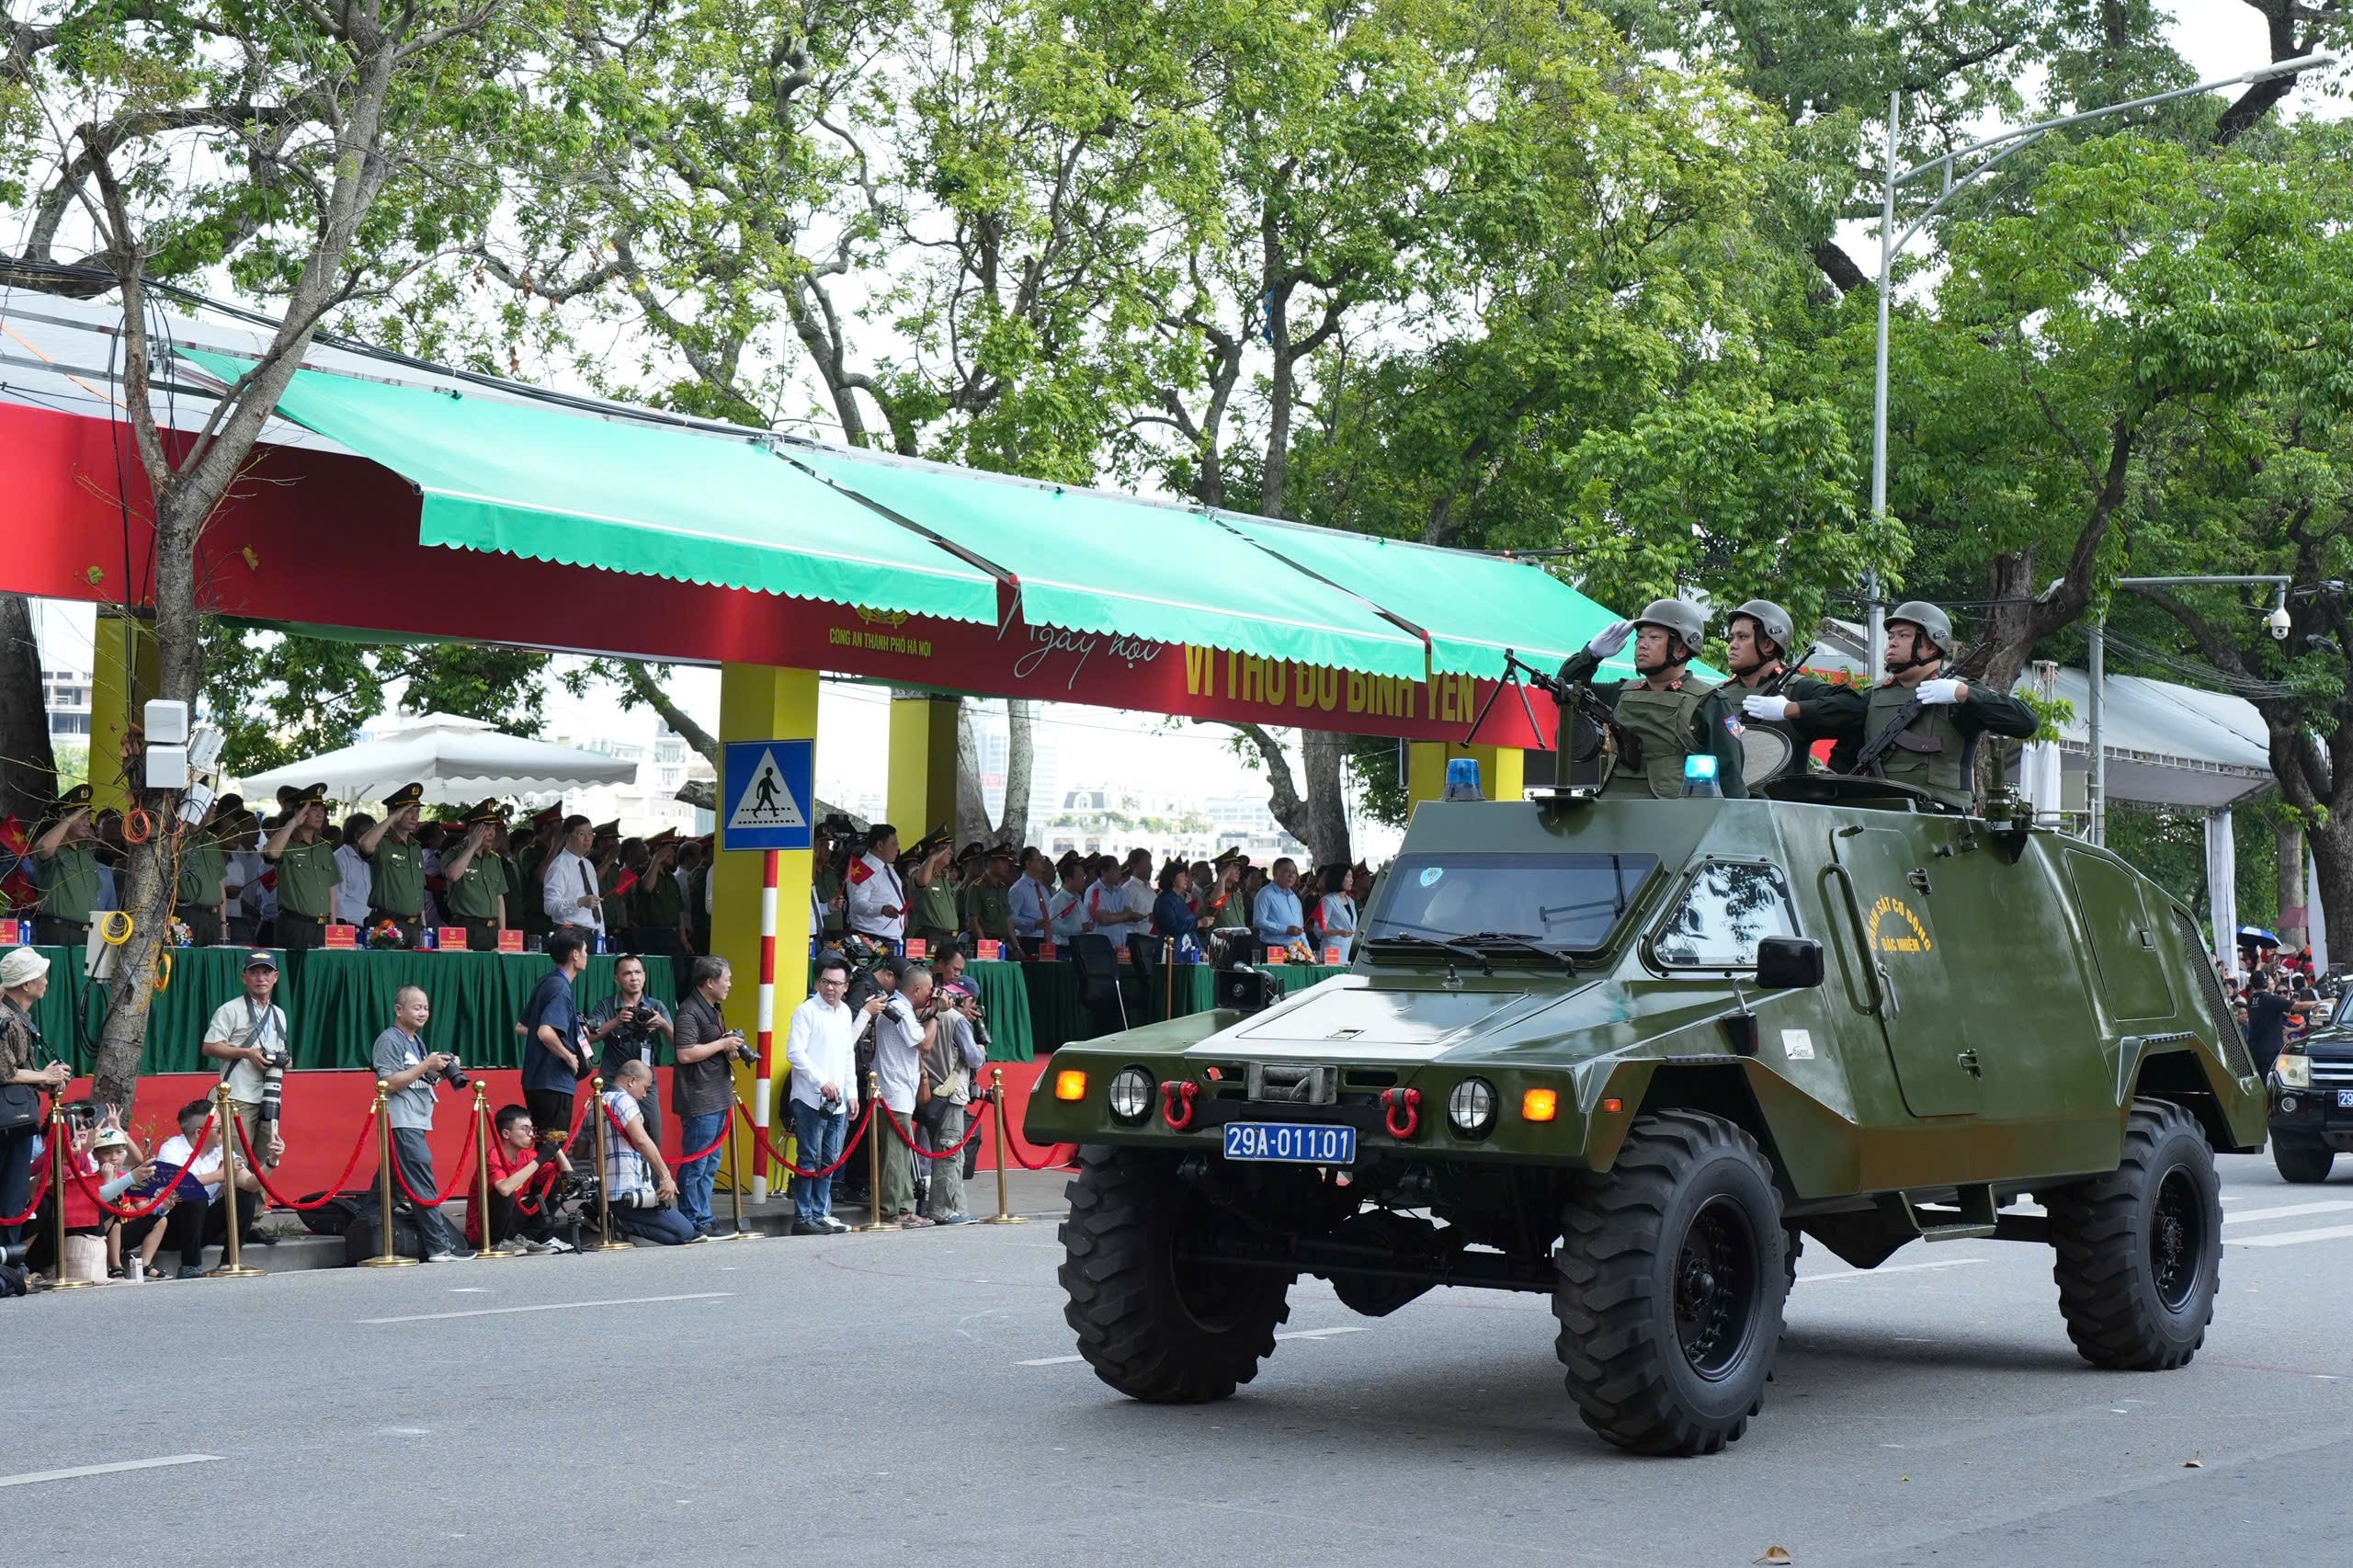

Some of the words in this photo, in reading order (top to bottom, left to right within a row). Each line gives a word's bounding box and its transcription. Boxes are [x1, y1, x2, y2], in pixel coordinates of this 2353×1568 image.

[829, 627, 851, 645] CÔNG
[852, 631, 863, 647] AN
[864, 631, 889, 652] THÀNH
[890, 634, 906, 653] PHỐ
[907, 638, 917, 655] HÀ
[918, 640, 931, 659] NỘI
[1228, 1127, 1349, 1159] 29A-011.01
